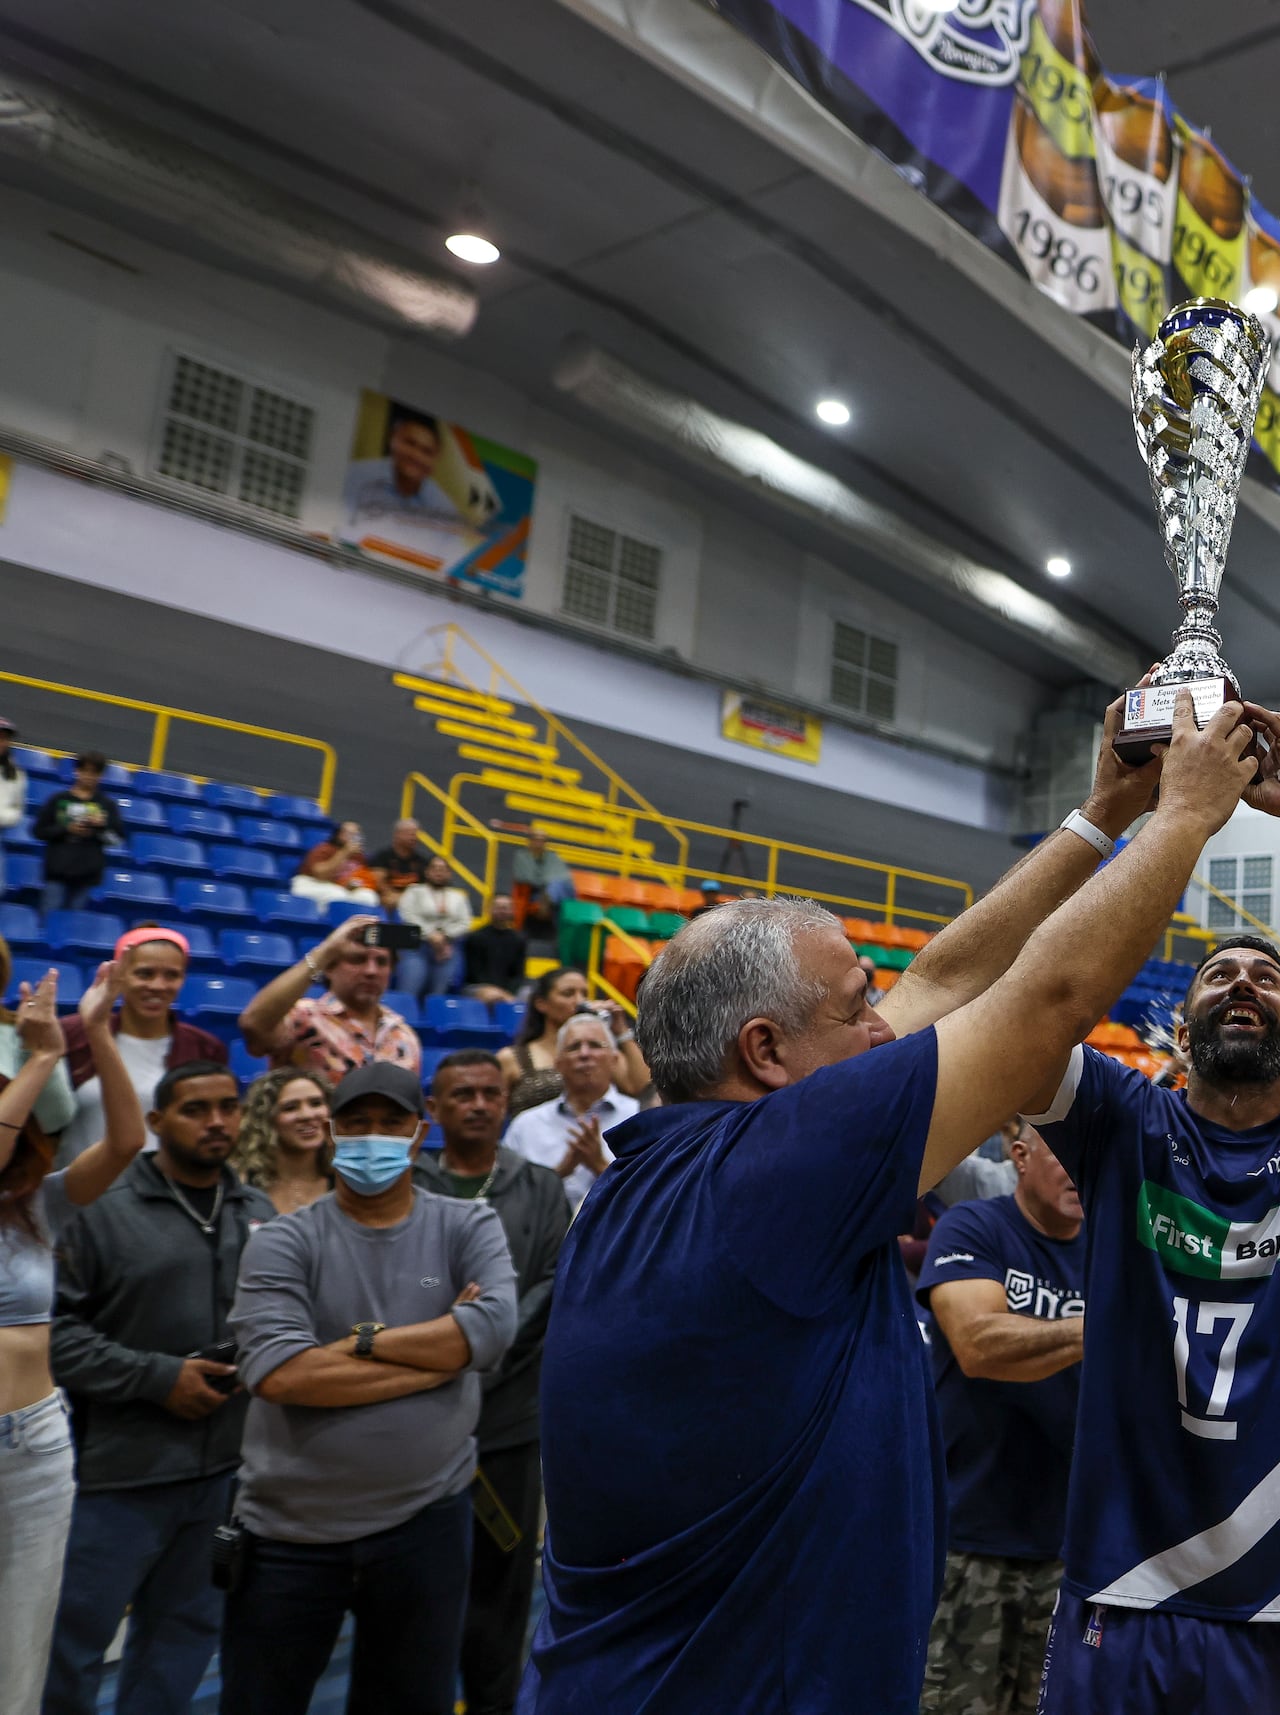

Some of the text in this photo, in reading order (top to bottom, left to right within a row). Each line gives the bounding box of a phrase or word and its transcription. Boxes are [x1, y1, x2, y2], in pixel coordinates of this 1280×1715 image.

[1014, 209, 1104, 294] 1986
[1174, 223, 1236, 291] 1967
[1127, 712, 1140, 720] LVS
[1151, 698, 1171, 707] Mets
[1153, 1213, 1213, 1258] First
[1173, 1297, 1255, 1416] 17
